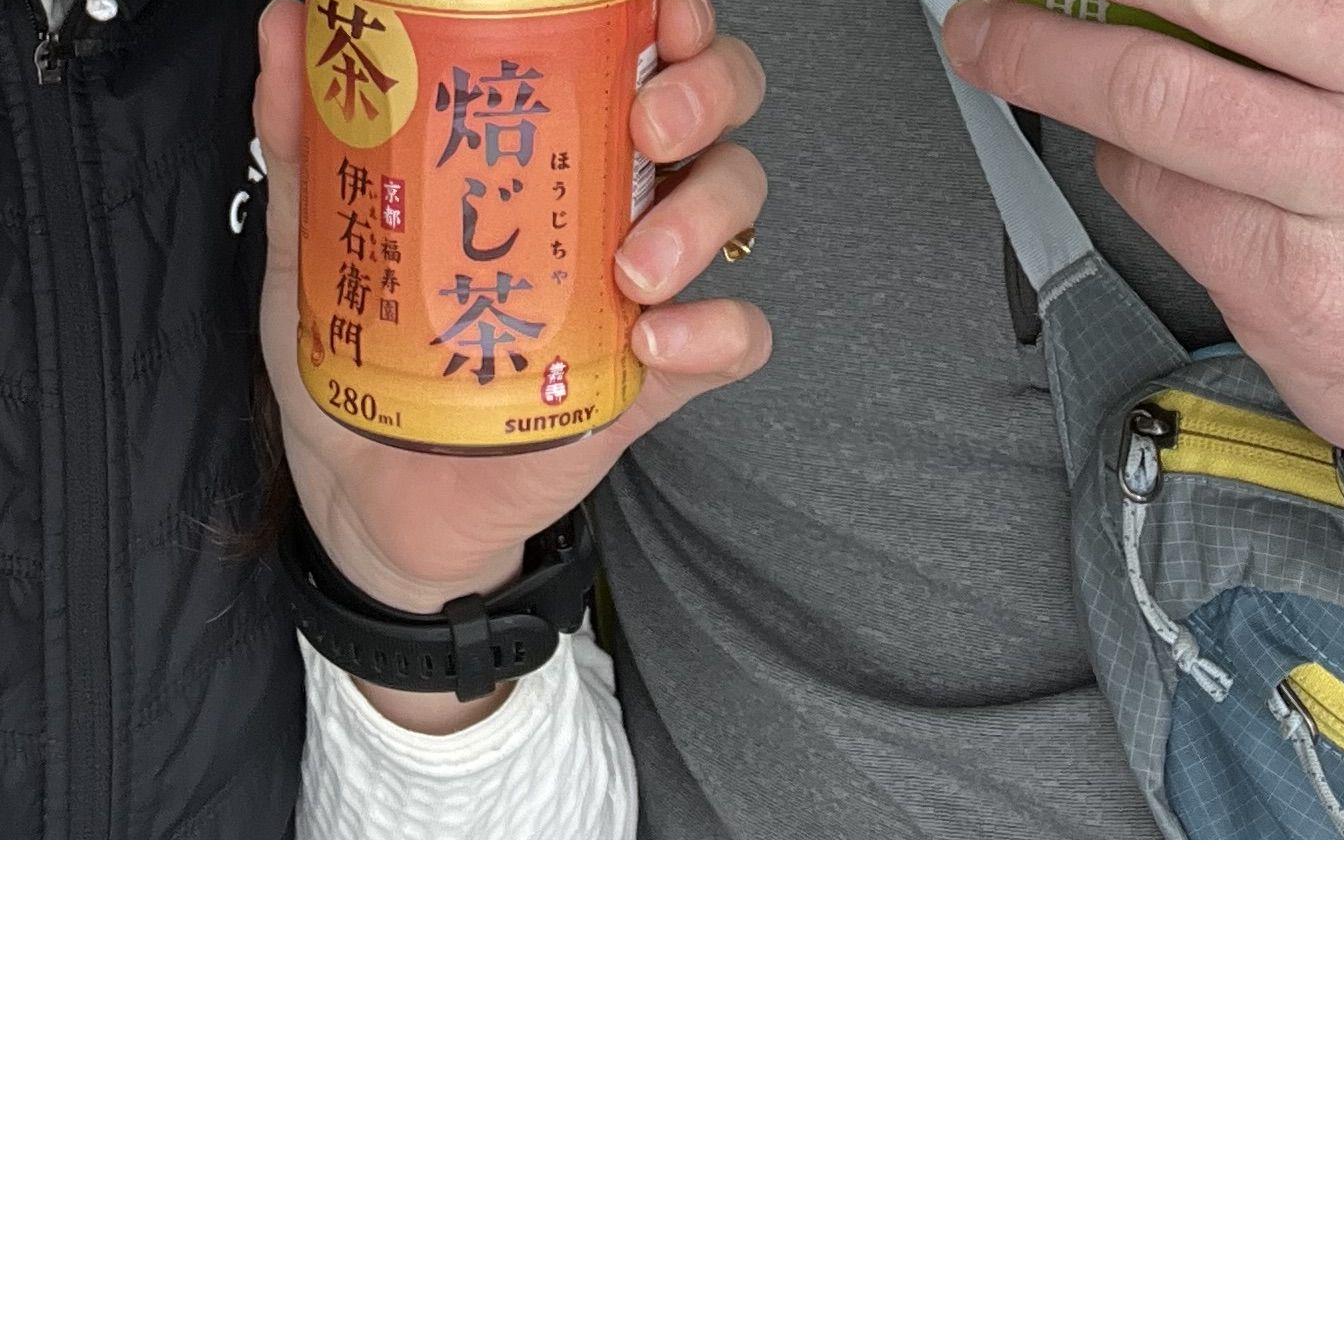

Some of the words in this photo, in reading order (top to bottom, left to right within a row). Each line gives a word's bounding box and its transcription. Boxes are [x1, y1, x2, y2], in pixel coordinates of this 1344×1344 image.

[383, 180, 402, 230] 京都
[429, 59, 552, 386] 焙じ茶
[329, 156, 373, 368] 伊右衛門
[379, 237, 402, 325] 福寿園
[328, 378, 402, 429] 280ml
[503, 404, 596, 434] SUNTORY
